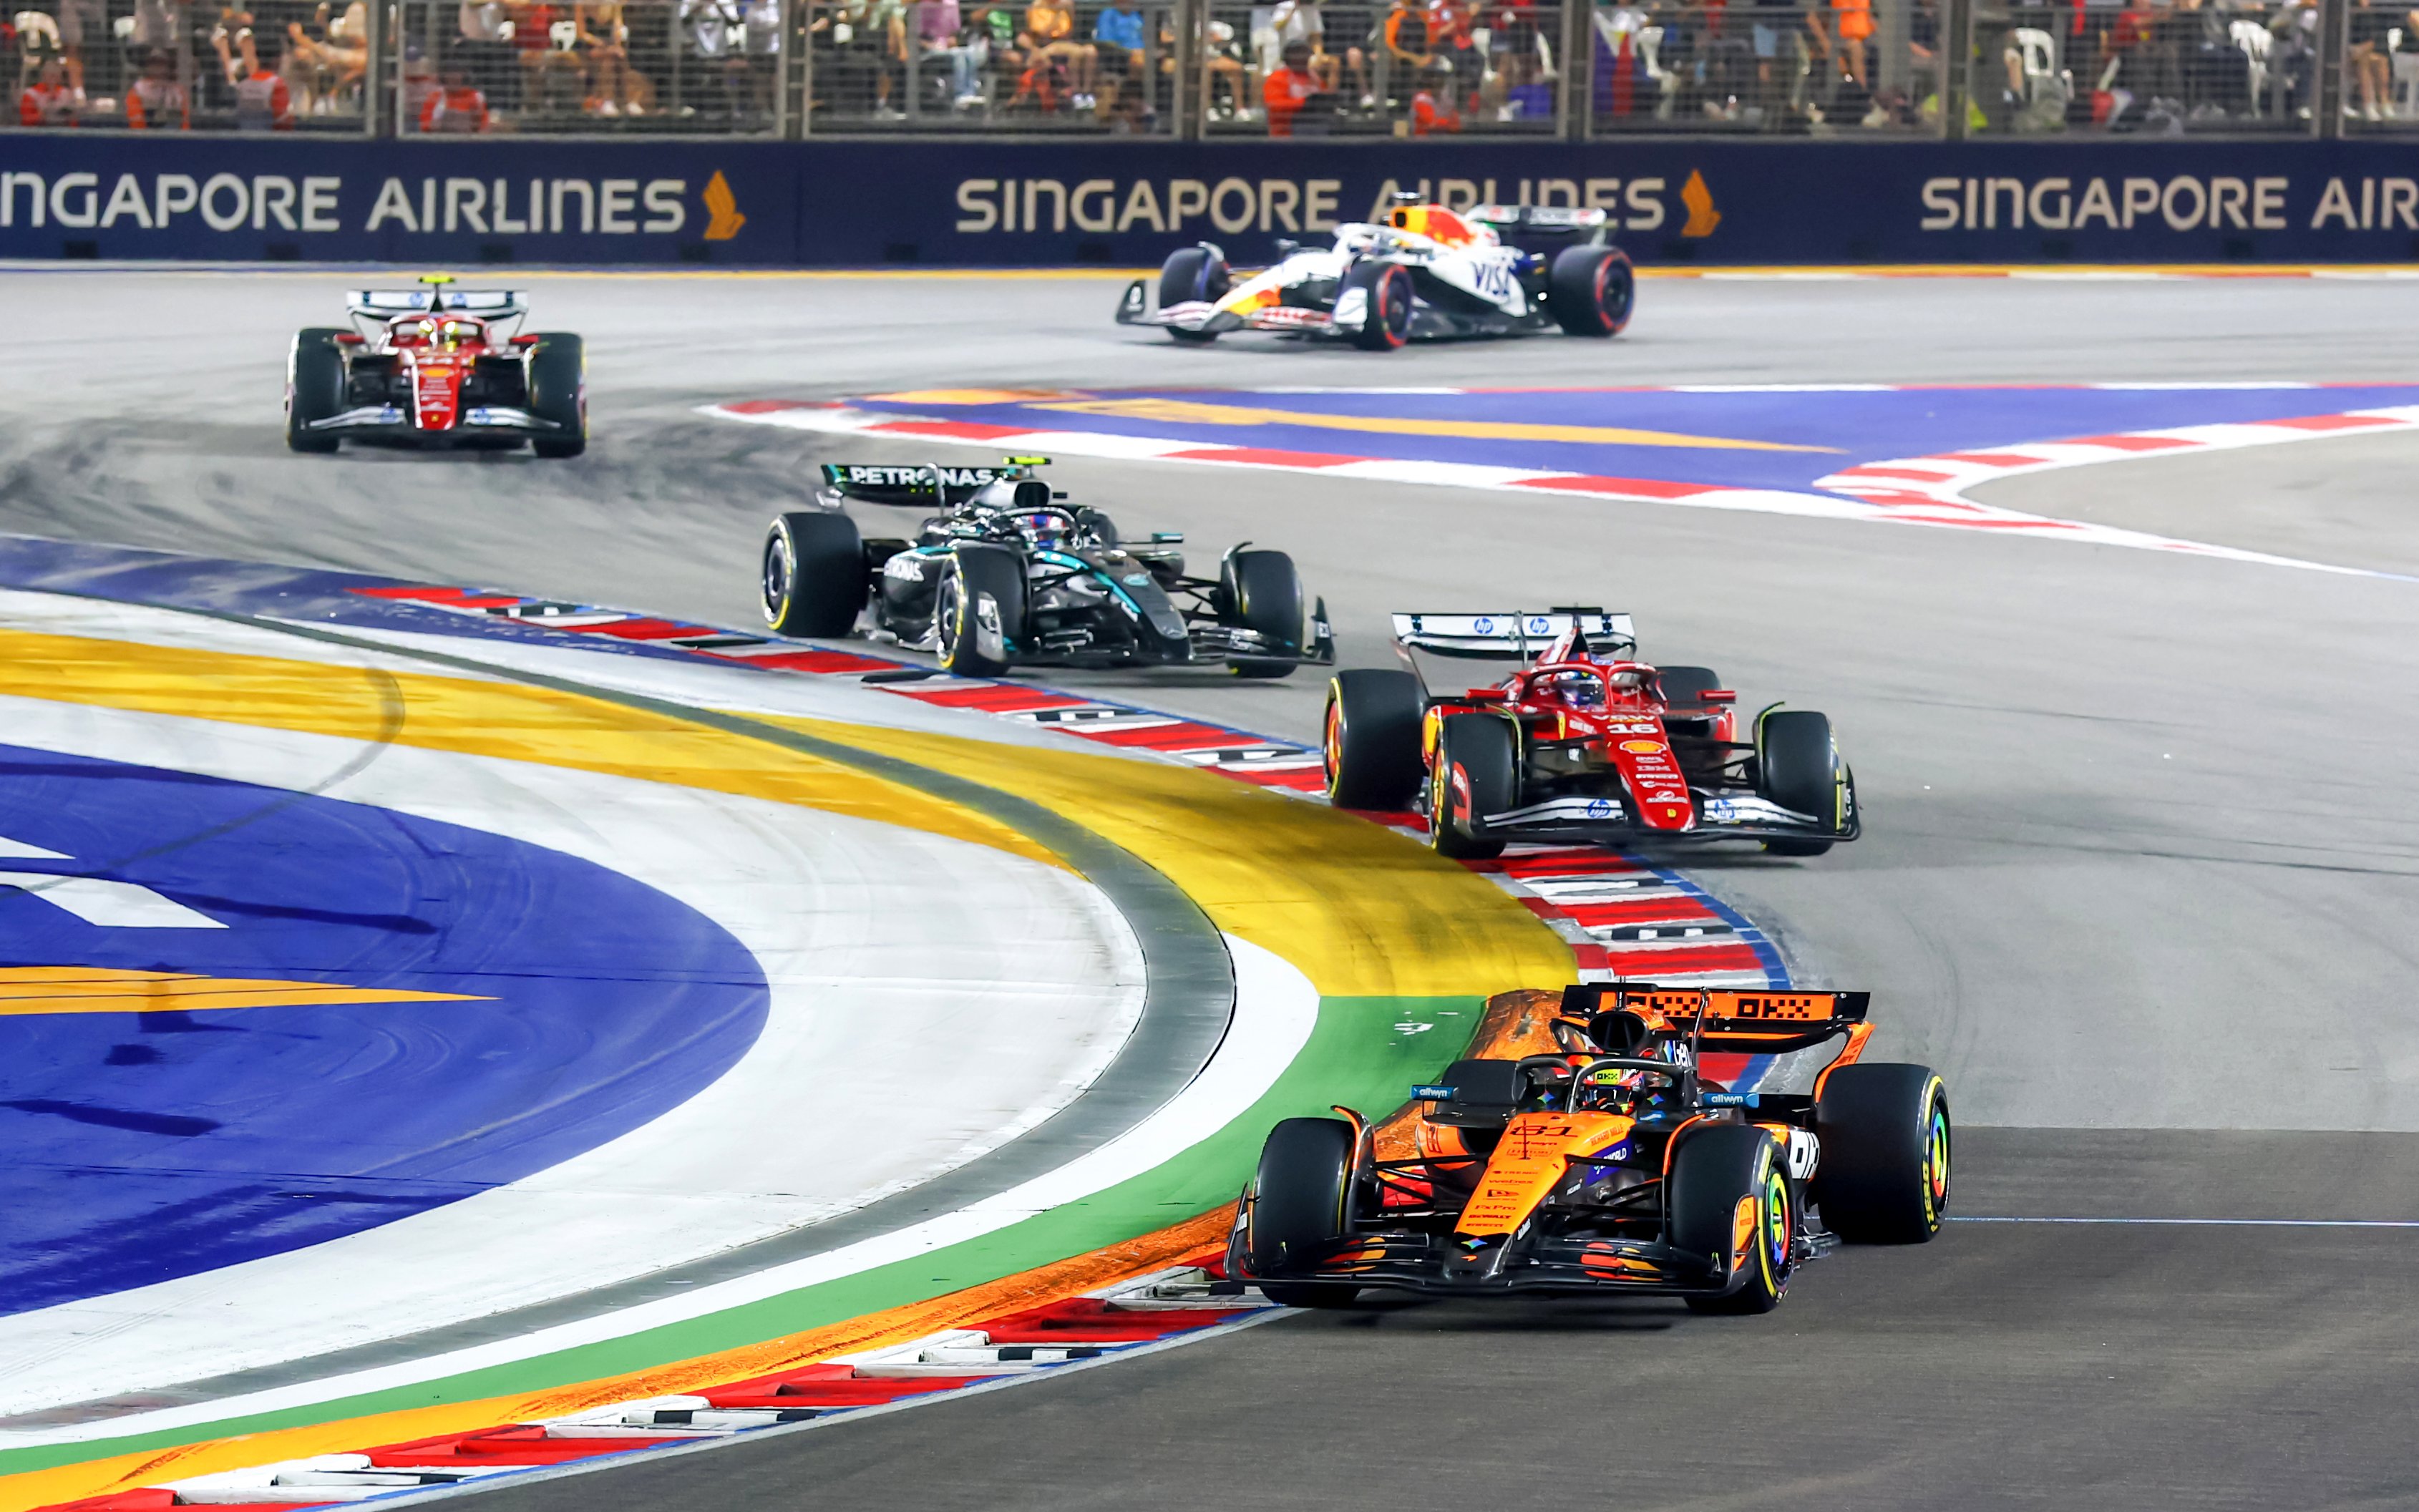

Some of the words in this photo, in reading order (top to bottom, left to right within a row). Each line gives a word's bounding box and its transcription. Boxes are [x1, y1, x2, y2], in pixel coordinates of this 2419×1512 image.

[366, 178, 685, 233] AIRLINES
[957, 178, 1340, 232] SINGAPORE
[1922, 176, 2288, 230] SINGAPORE
[1474, 618, 1493, 634] hp
[1530, 618, 1549, 634] hp
[1607, 723, 1658, 733] 16
[1587, 799, 1610, 819] hp
[1736, 998, 1811, 1018] OKX
[1419, 1087, 1447, 1098] allwyn
[1711, 1093, 1743, 1105] allwyn
[1509, 1126, 1578, 1138] 81
